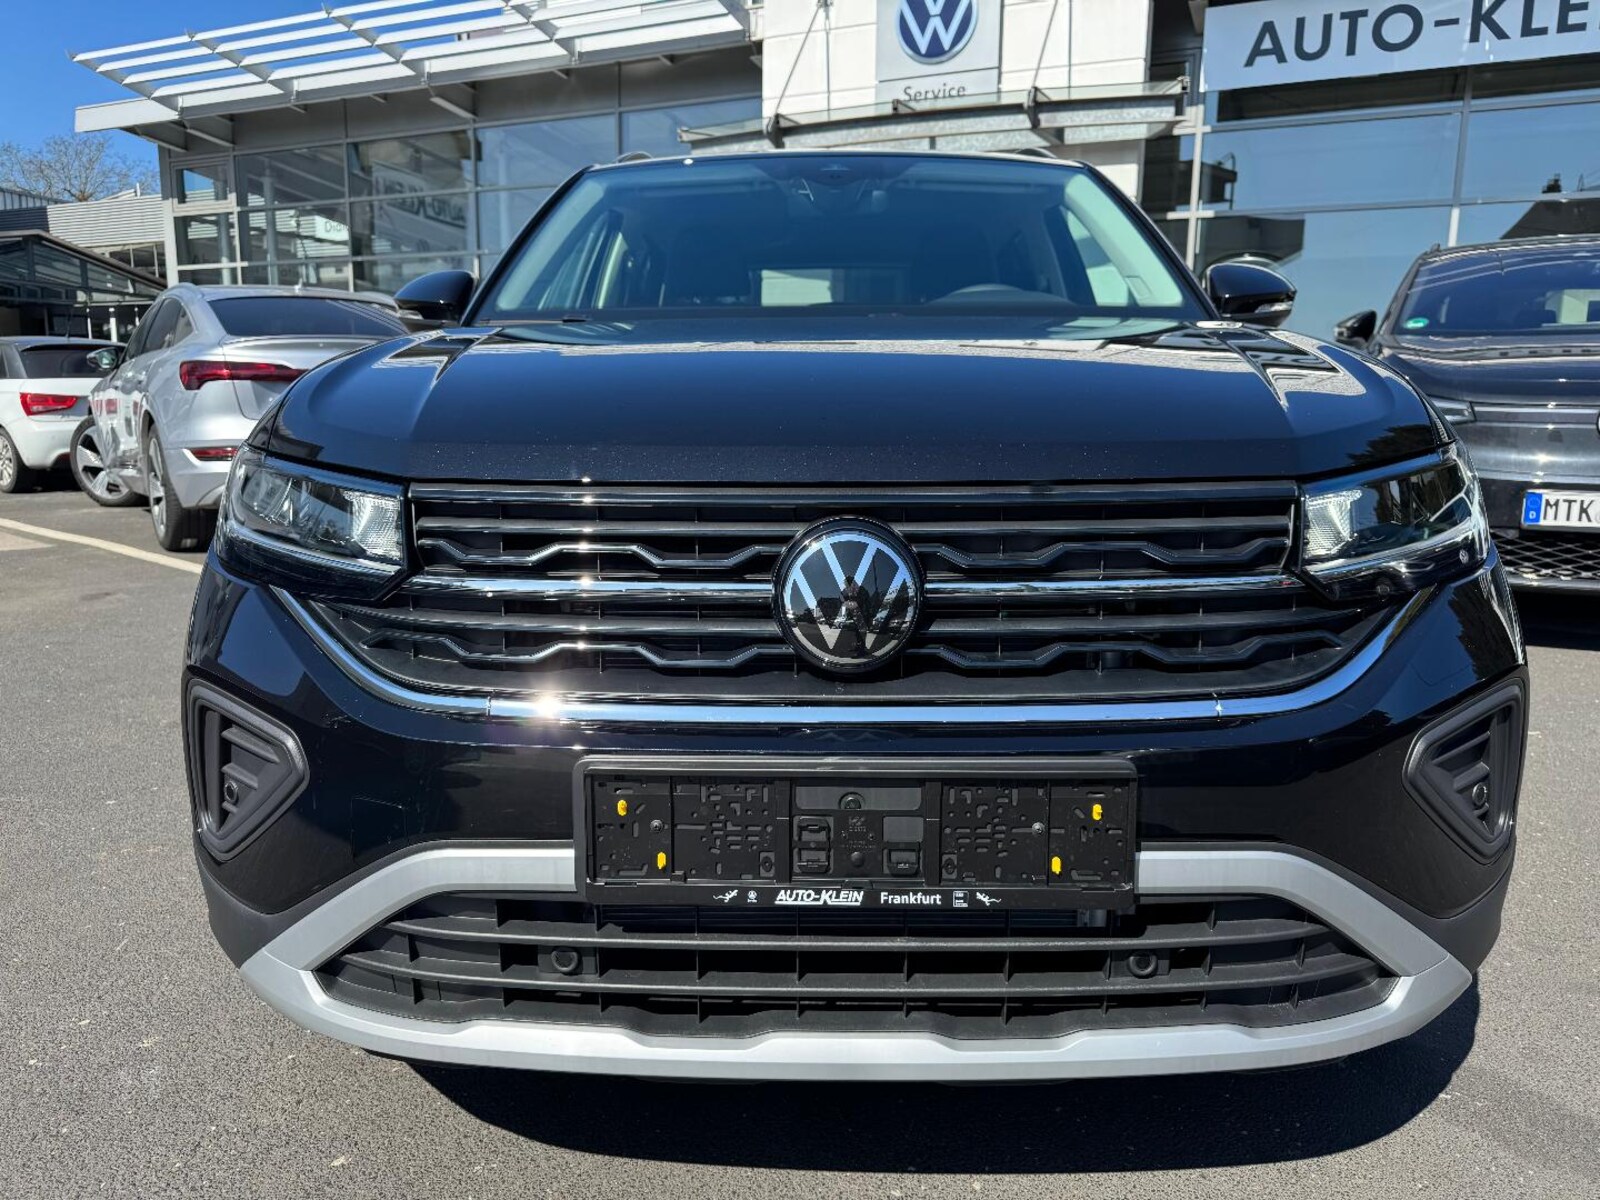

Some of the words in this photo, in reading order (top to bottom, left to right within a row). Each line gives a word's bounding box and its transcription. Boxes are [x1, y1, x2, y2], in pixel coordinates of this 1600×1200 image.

[1244, 0, 1600, 68] AUTO-KLE
[903, 82, 967, 101] Service
[1543, 498, 1594, 523] MTK
[787, 534, 914, 656] VW
[775, 890, 864, 905] AUTO-KLEIN
[880, 891, 942, 905] Frankfurt
